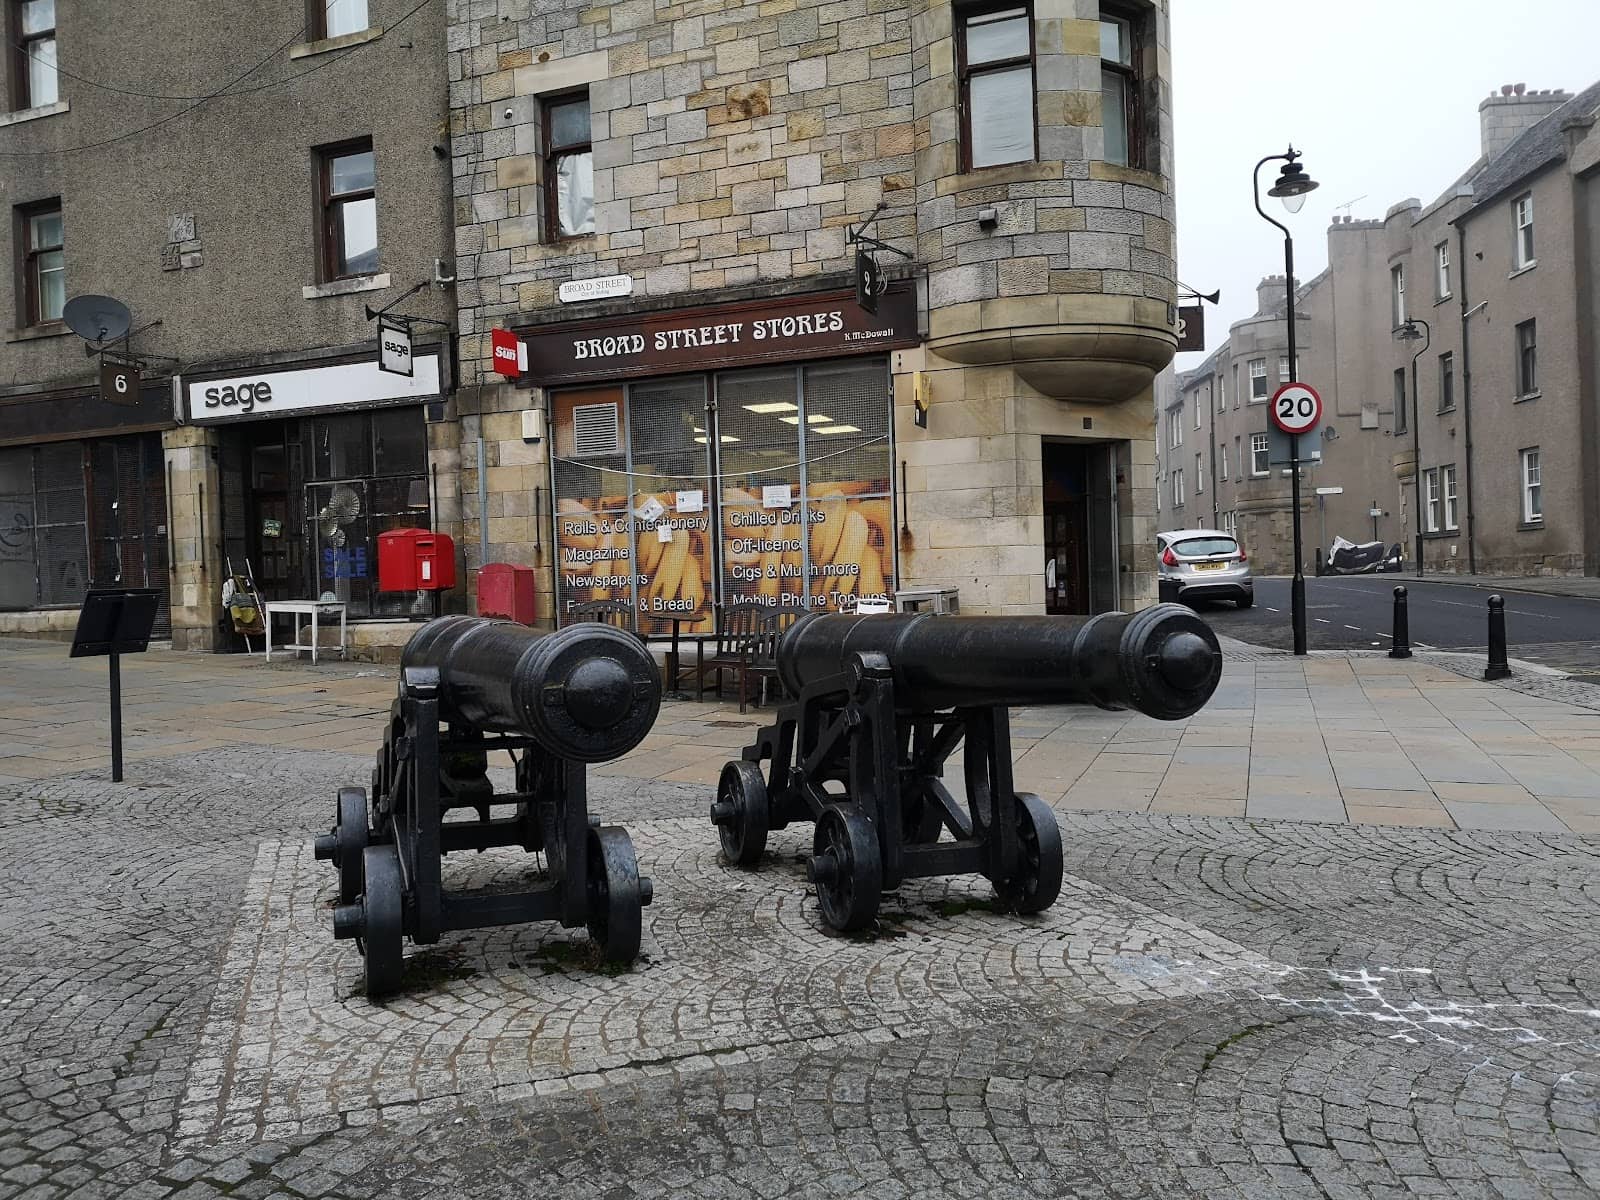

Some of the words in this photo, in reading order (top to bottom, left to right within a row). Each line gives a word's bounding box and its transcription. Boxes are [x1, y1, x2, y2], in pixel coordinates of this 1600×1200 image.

[564, 282, 593, 293] BROAD
[595, 278, 627, 289] STREET
[864, 271, 871, 296] 2
[573, 334, 645, 359] BROAD
[654, 323, 743, 351] STREET
[753, 311, 844, 340] STORES
[384, 339, 409, 357] sage
[495, 345, 516, 361] Sun
[115, 374, 127, 393] 6
[205, 381, 273, 412] sage
[1279, 397, 1314, 418] 20
[730, 510, 776, 527] Chilled
[781, 508, 825, 525] Driks
[564, 521, 597, 535] Rolls
[600, 519, 611, 533] &
[731, 537, 803, 553] Off-licenc
[732, 565, 762, 581] Cigs
[766, 564, 777, 578] &
[780, 562, 818, 577] Muh
[823, 563, 859, 576] more
[566, 574, 648, 590] Newspapers
[640, 597, 649, 611] &
[653, 597, 694, 611] Bread
